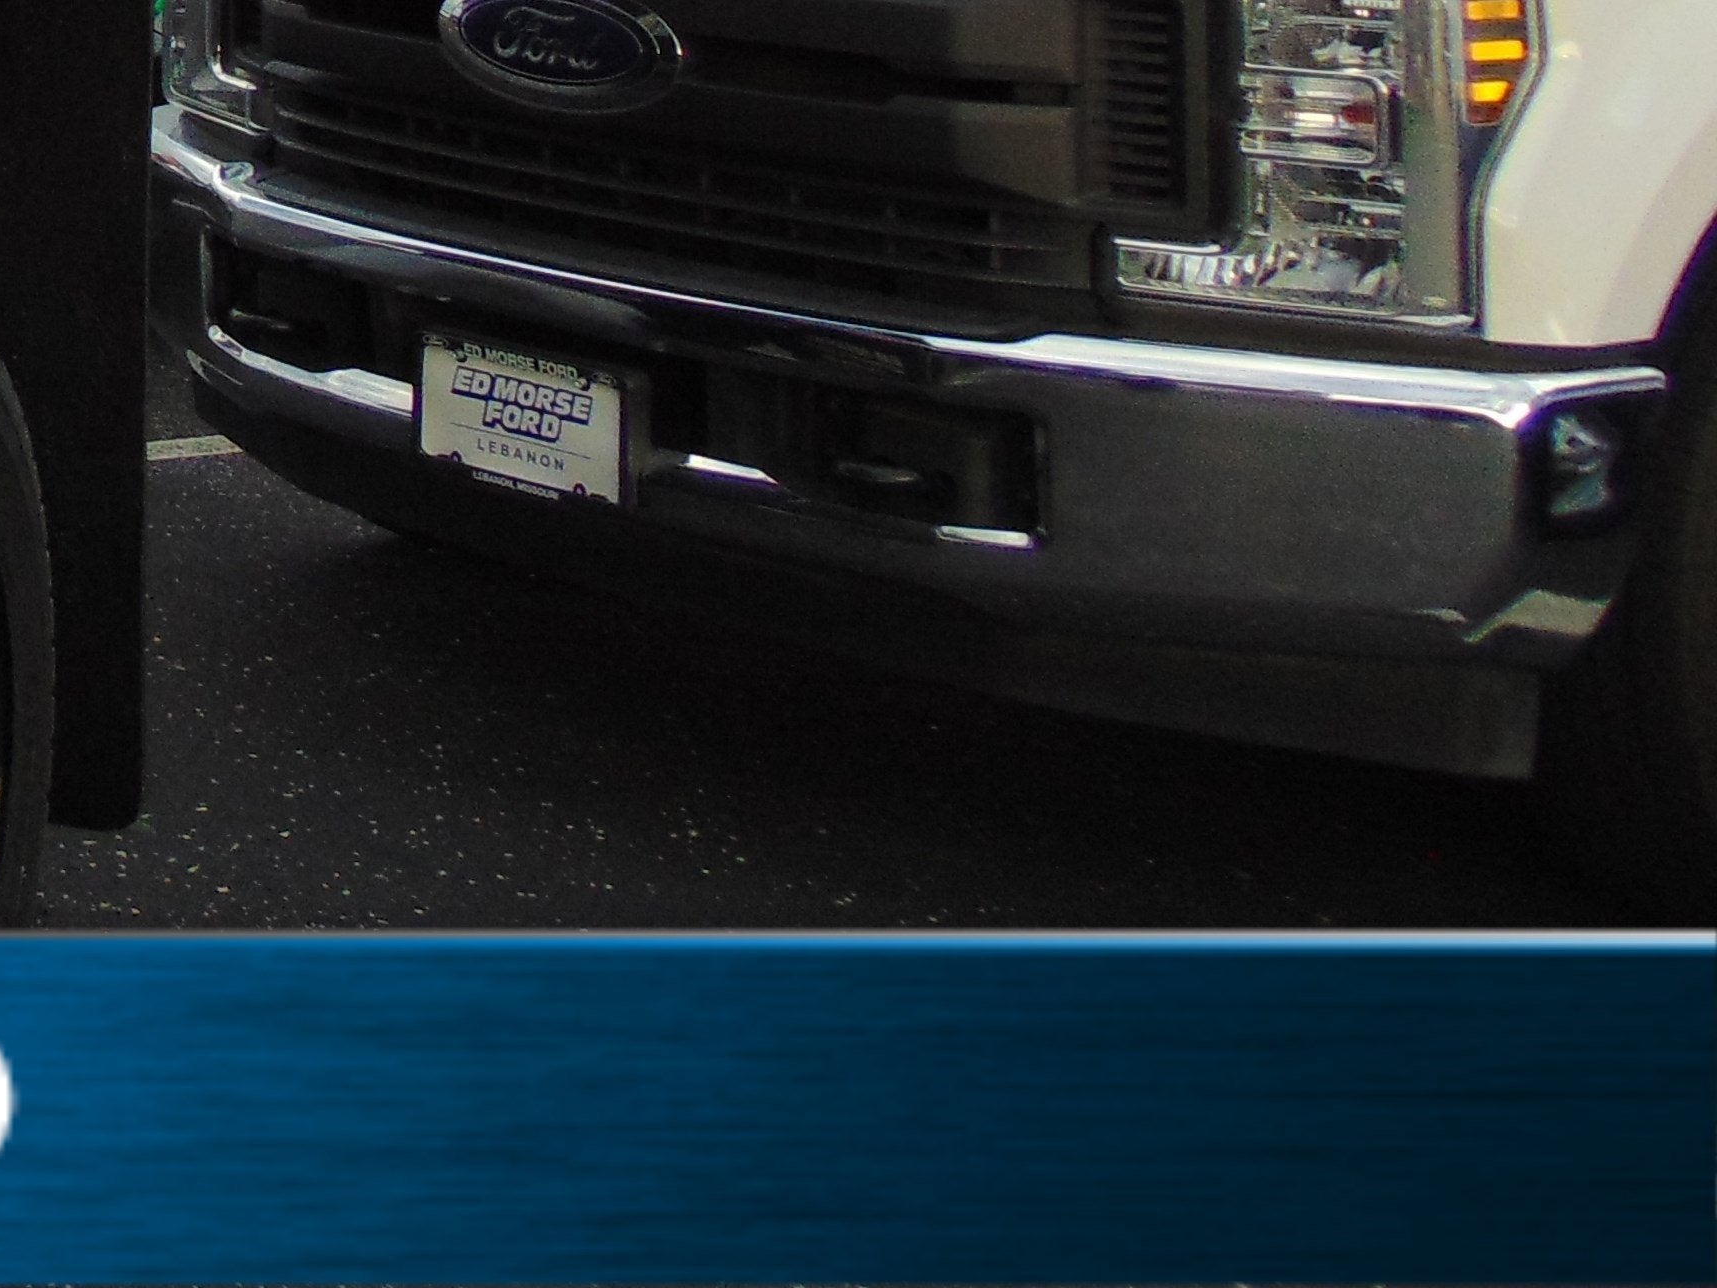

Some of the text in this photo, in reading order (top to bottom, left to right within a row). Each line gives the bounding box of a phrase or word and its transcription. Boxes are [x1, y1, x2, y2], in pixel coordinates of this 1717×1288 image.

[492, 5, 603, 72] Ford
[464, 343, 578, 378] ED MORSE FORD
[452, 367, 593, 424] ED MORSE
[484, 400, 561, 442] FORD
[477, 438, 565, 471] LEBANON
